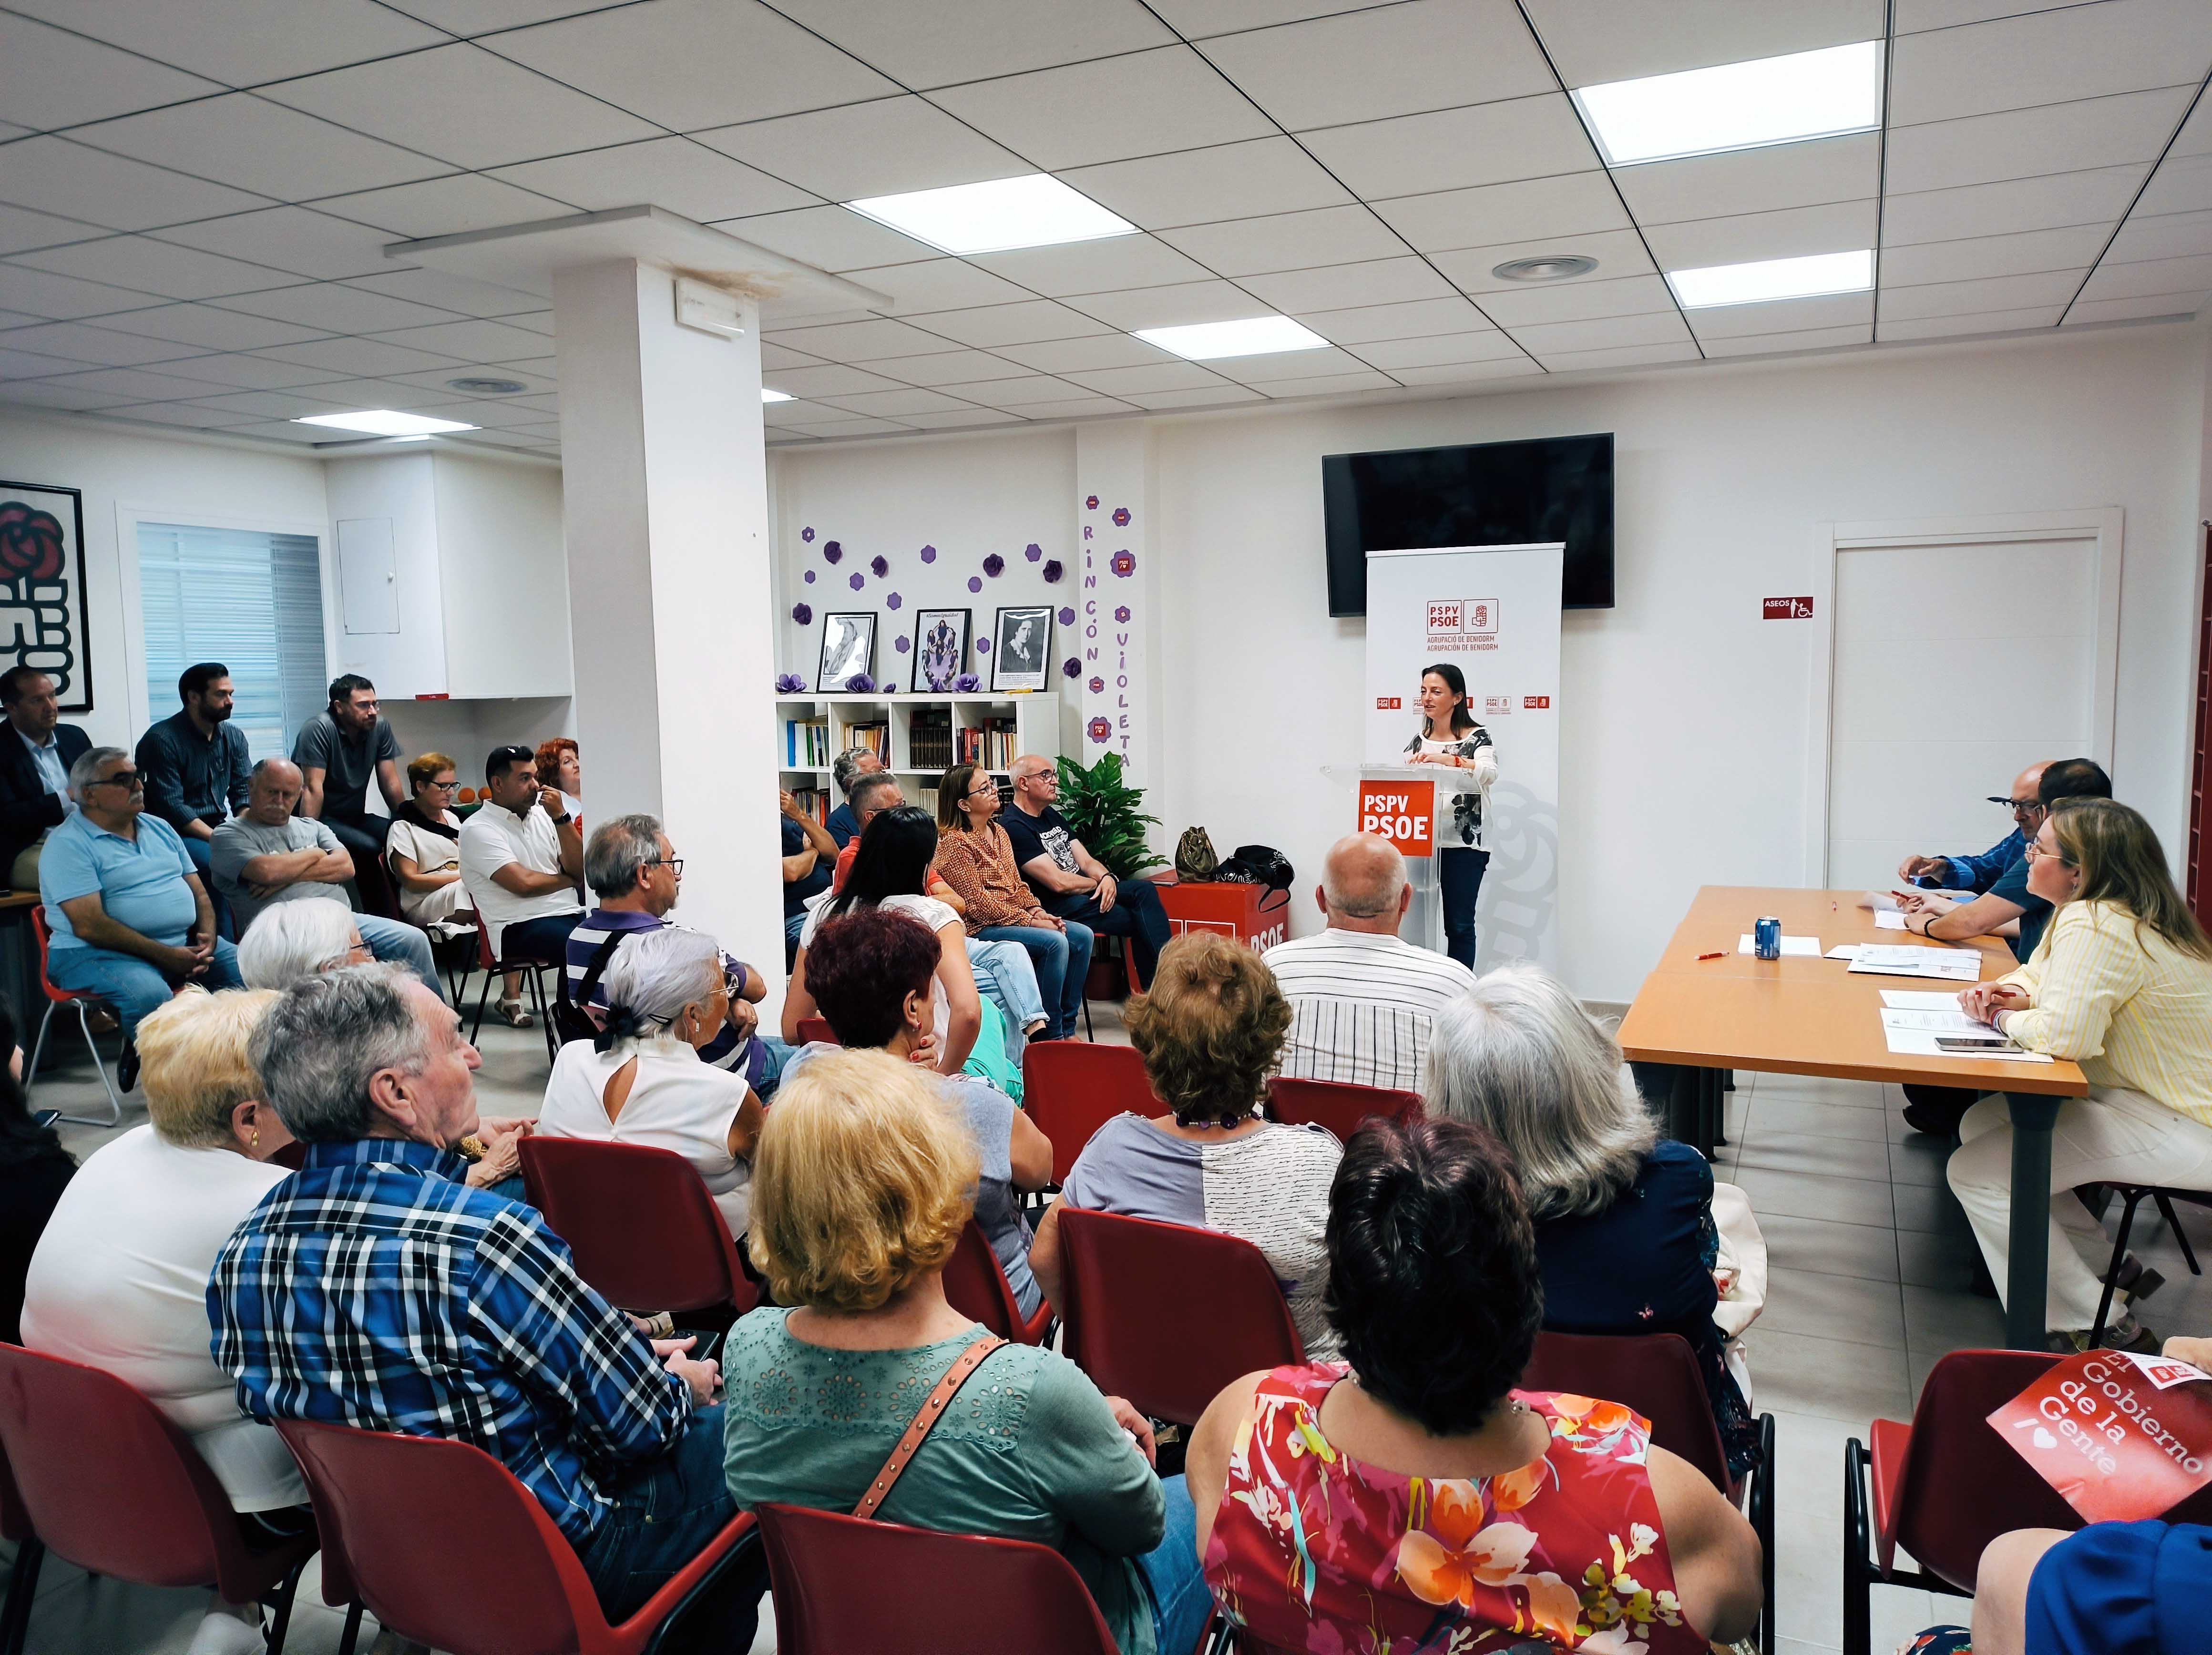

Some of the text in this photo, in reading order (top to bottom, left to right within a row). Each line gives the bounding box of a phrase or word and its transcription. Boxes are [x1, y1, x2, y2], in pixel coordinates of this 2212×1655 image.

[1430, 606, 1459, 615] PSPV
[1430, 616, 1459, 627] PSOE
[1427, 635, 1456, 643] AGRUPACIÓ
[1427, 643, 1460, 652] AGRUPACIÓN
[1364, 795, 1409, 813] PSPV
[1364, 815, 1428, 840] PSOE
[2060, 1381, 2126, 1445] de la
[2083, 1362, 2204, 1474] Gobierno
[2039, 1396, 2117, 1475] Gente
